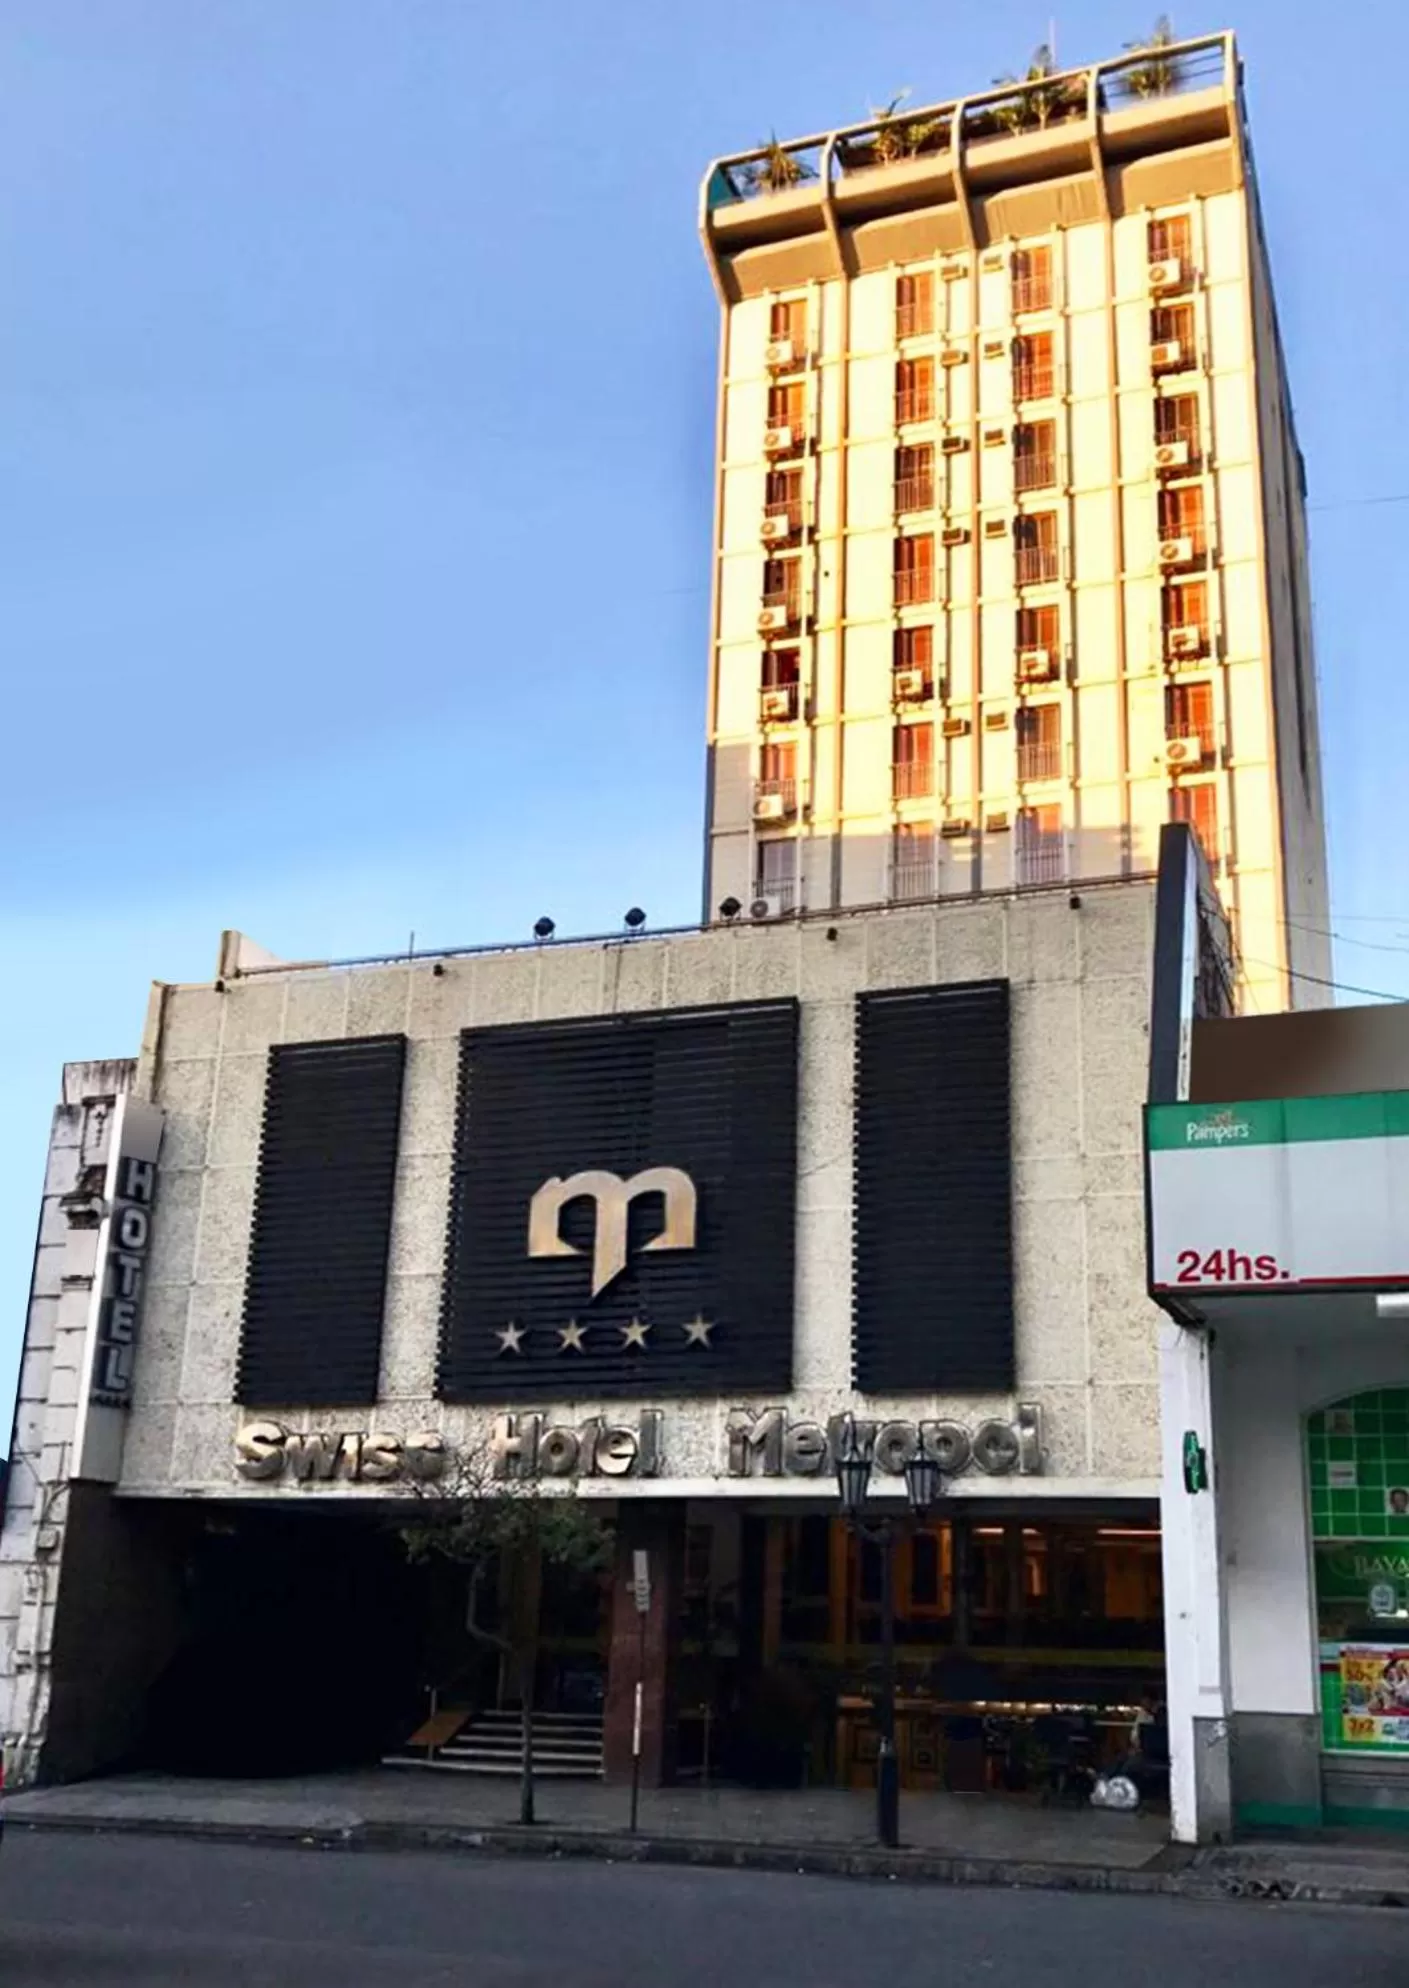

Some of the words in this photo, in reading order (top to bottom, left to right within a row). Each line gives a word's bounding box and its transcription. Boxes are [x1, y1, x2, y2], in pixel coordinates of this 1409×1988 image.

[1186, 1121, 1250, 1143] Pampers
[105, 1159, 153, 1391] HOTEL
[1177, 1249, 1289, 1283] 24hs.
[492, 1408, 665, 1478] Hotel
[725, 1402, 1043, 1476] Metropol
